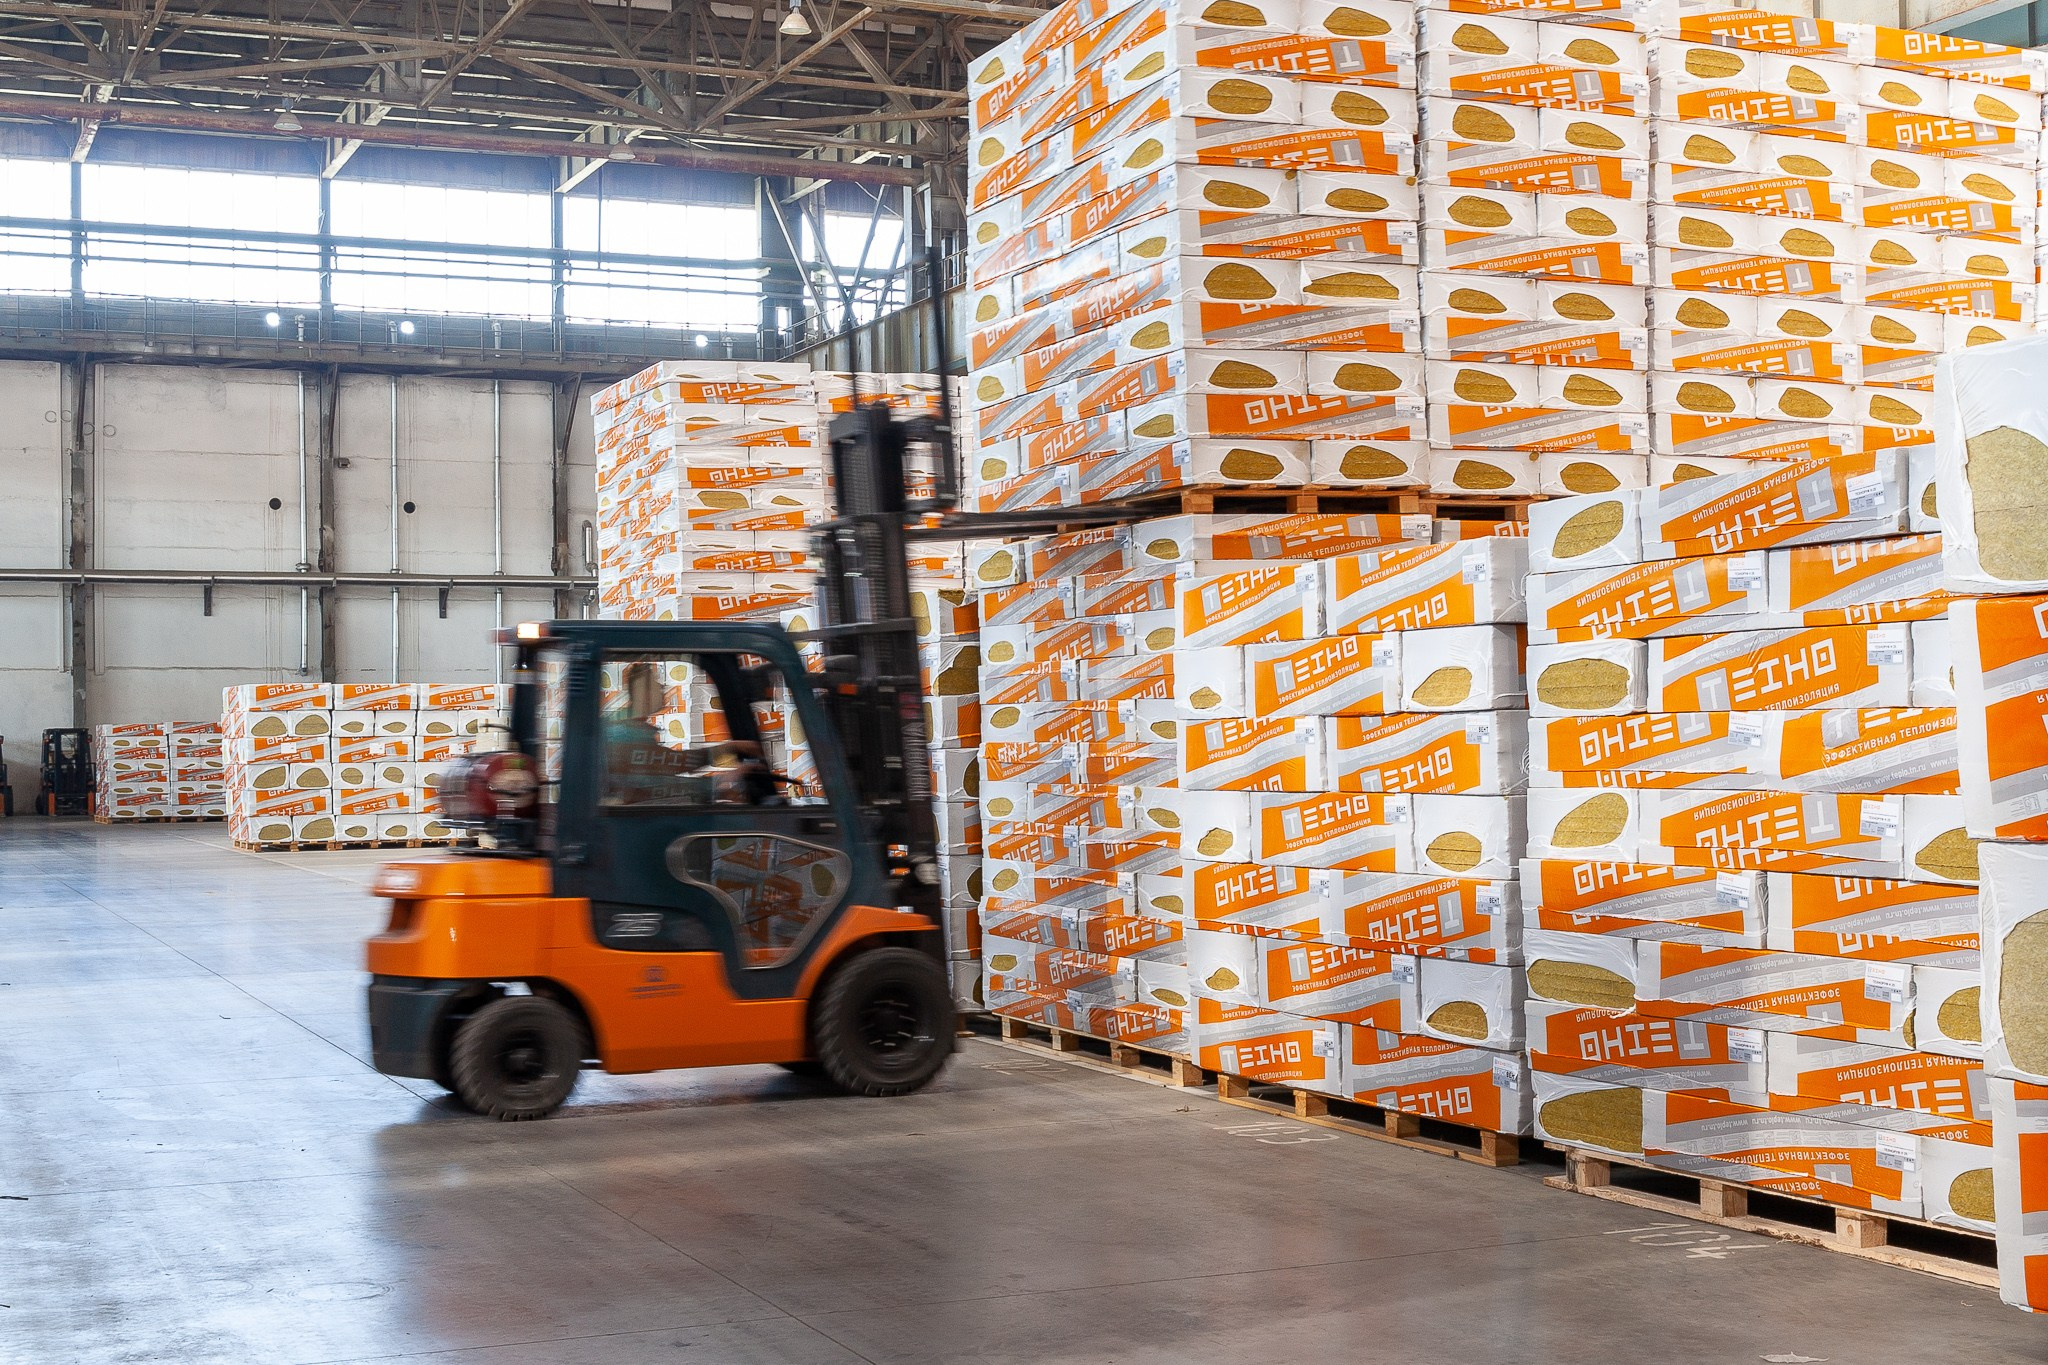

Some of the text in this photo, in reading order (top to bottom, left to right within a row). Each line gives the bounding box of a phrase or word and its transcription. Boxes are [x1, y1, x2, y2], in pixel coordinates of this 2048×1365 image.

[1692, 483, 1761, 523] ТЕПЛОИЗОЛЯЦИЯ
[1575, 568, 1642, 608] ТЕПЛОИЗОЛЯЦИЯ
[1824, 732, 1897, 763] ЭФФЕКТИВНАЯ
[1693, 788, 1767, 820] ТЕПЛОИЗОЛЯЦИЯ
[1292, 977, 1328, 993] ЭФФЕКТИВНАЯ
[1771, 988, 1840, 1006] ЭФФЕКТИВНАЯ
[1379, 1044, 1422, 1061] ЭФФЕКТИВНАЯ
[1836, 1059, 1923, 1081] ТЕПЛОИЗОЛЯЦИЯ
[1778, 1152, 1849, 1161] ЭФФЕКТИВНАЯ
